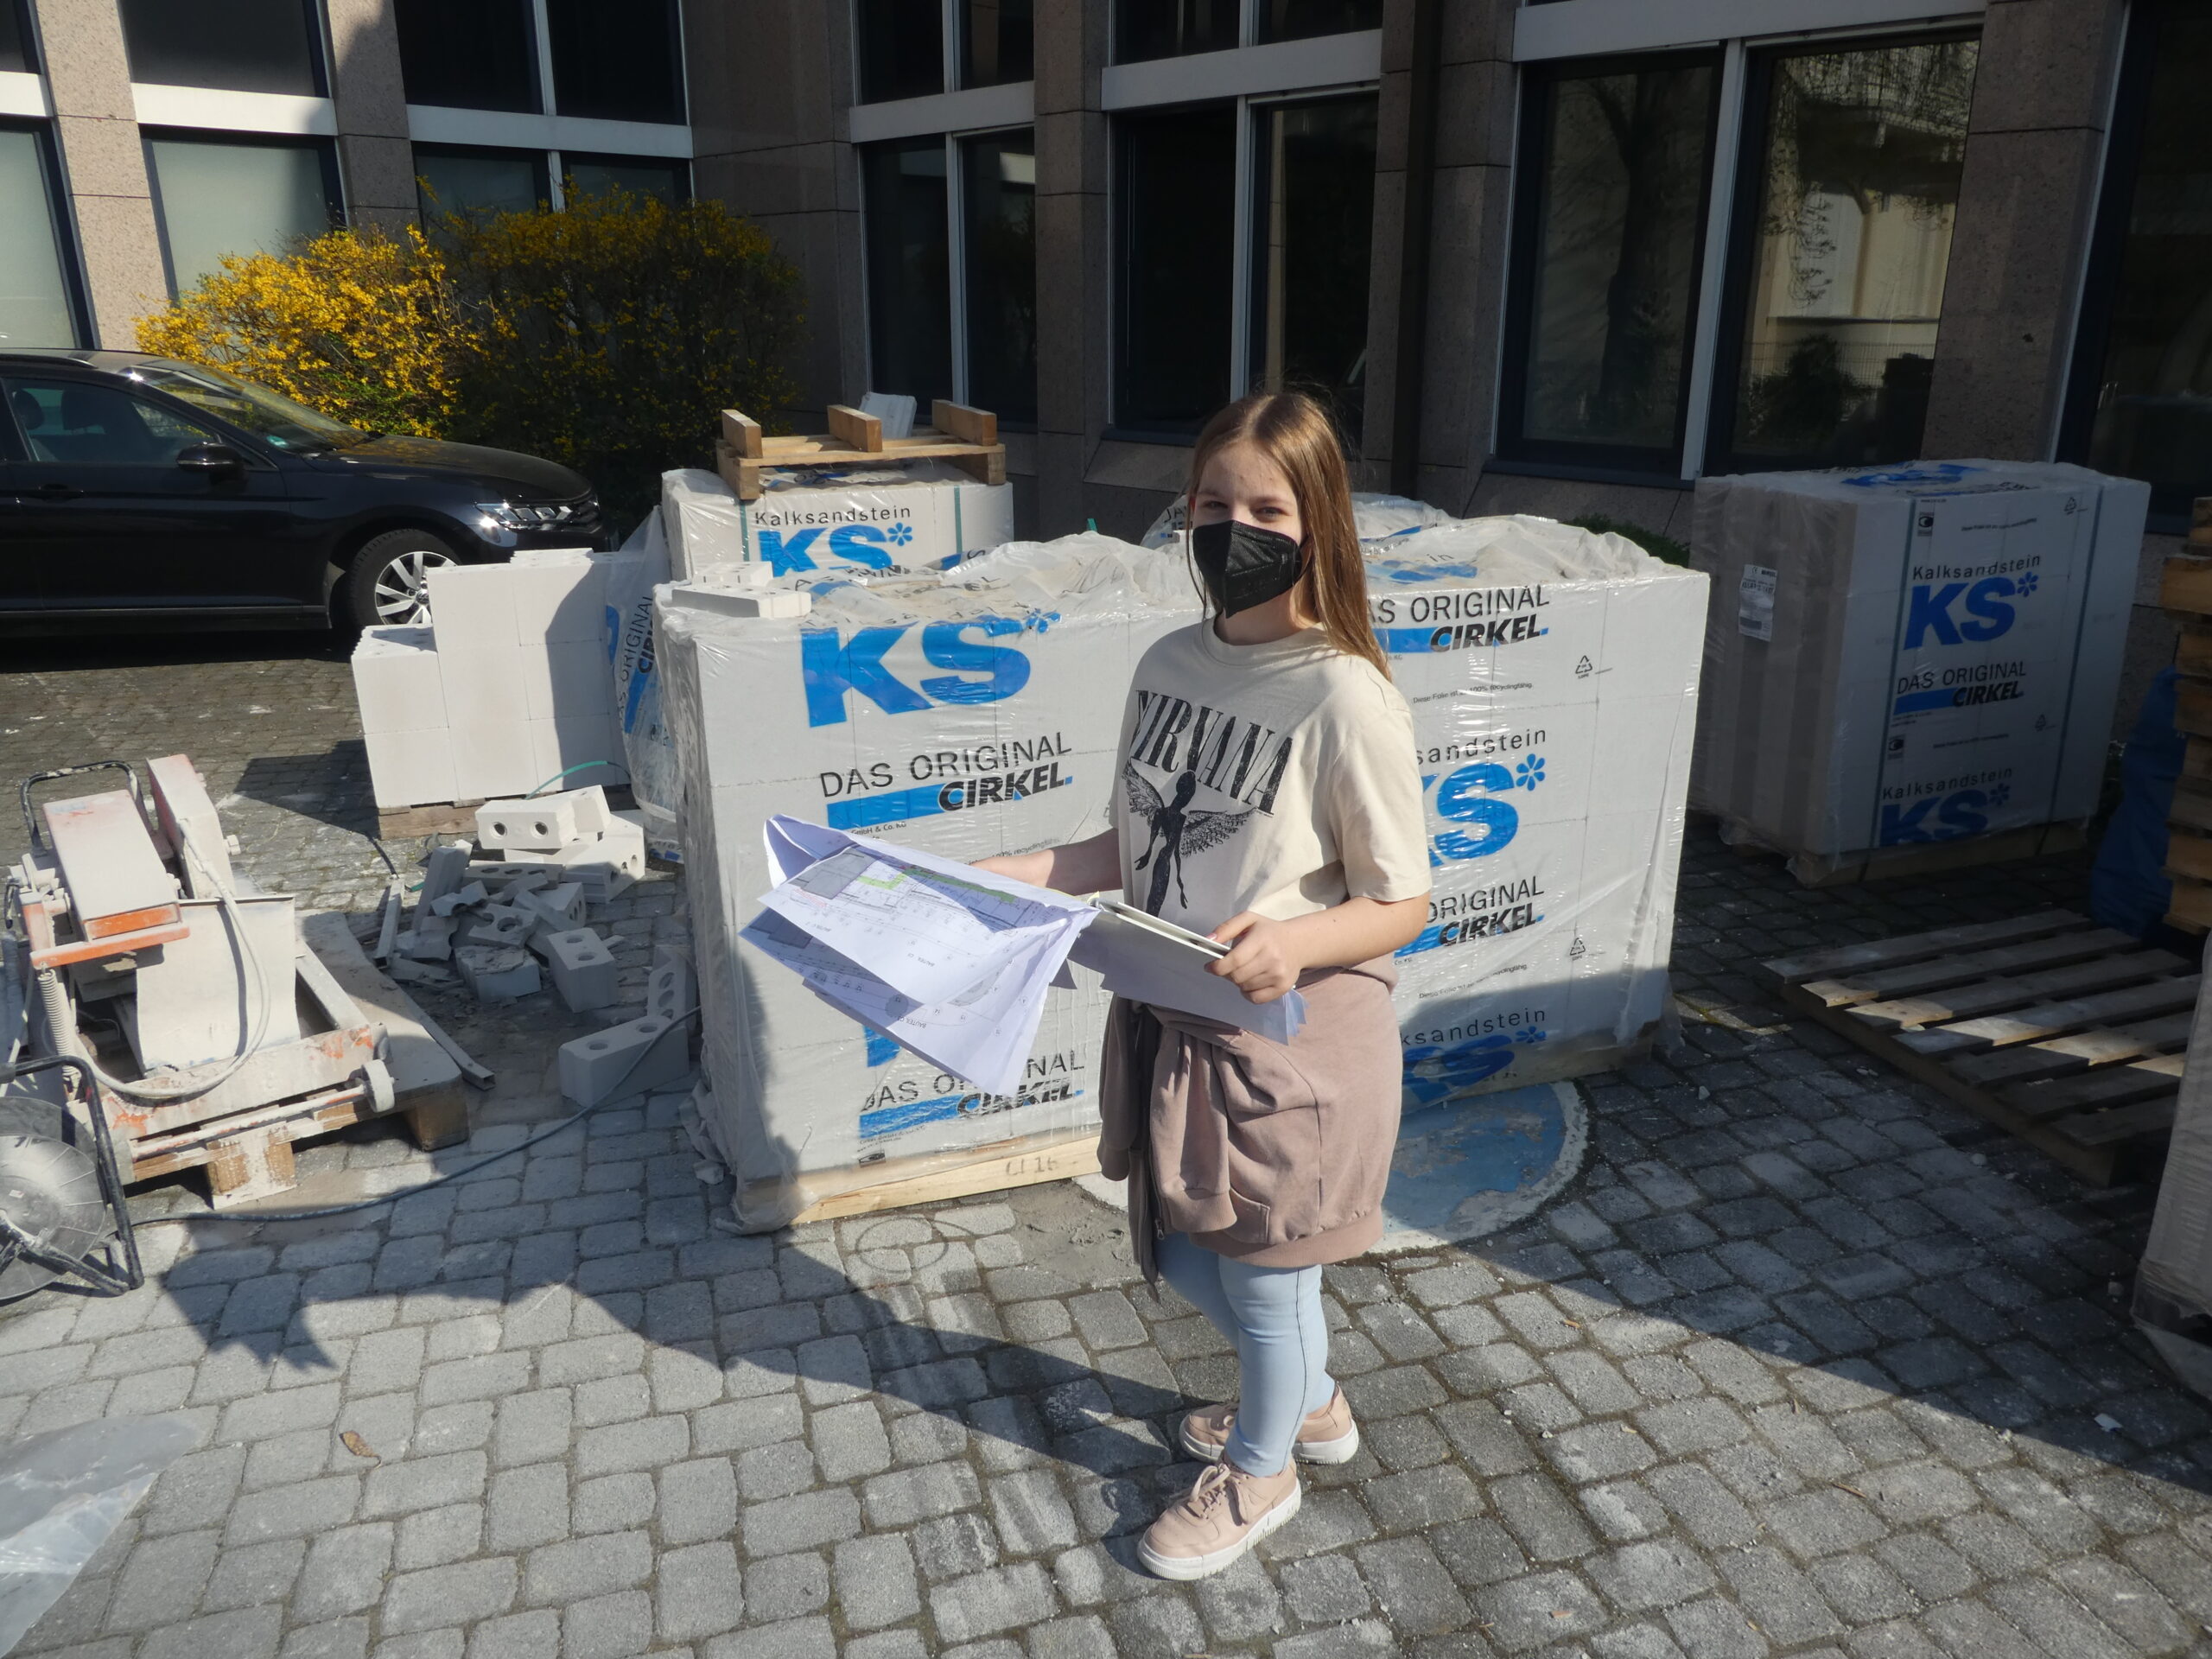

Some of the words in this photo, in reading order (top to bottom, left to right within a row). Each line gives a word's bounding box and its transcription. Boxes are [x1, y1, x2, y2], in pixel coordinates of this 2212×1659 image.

[754, 505, 911, 526] Kalksandstein
[1911, 555, 2041, 581] Kalksandstein
[1409, 584, 1550, 624] ORIGINAL
[1897, 673, 1935, 696] DAS
[1942, 659, 2027, 686] ORIGINAL
[819, 761, 894, 798] DAS
[909, 731, 1073, 782] ORIGINAL
[1129, 690, 1294, 816] NIRVANA
[1415, 728, 1547, 766] sandstein
[1881, 766, 2013, 800] Kalksandstein
[1401, 1007, 1547, 1046] ksandstein
